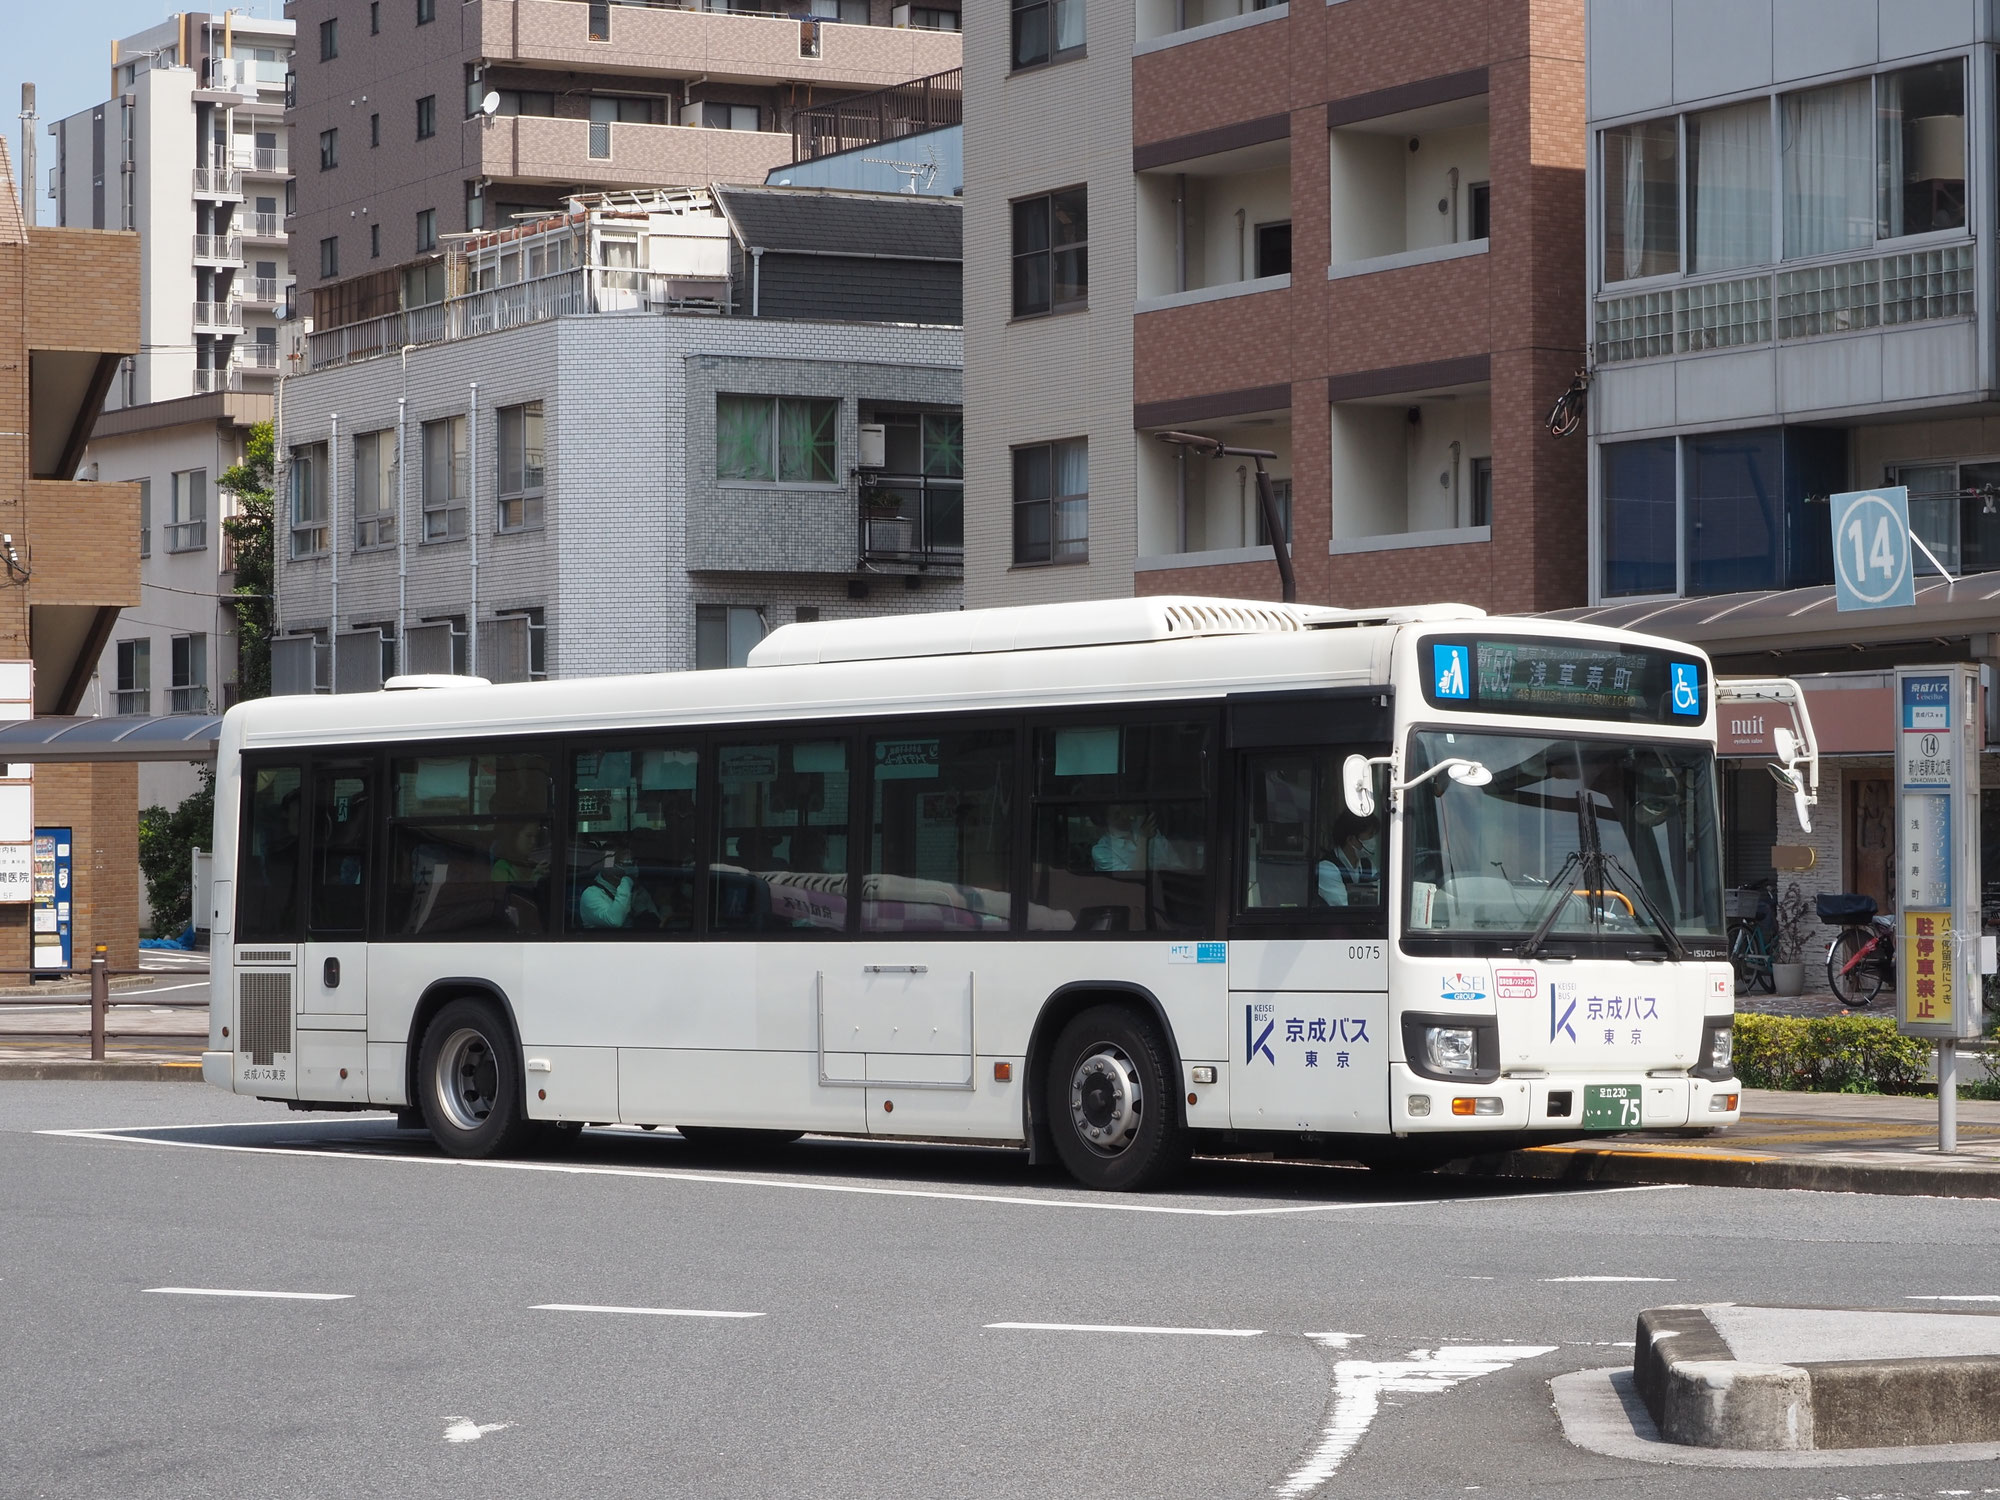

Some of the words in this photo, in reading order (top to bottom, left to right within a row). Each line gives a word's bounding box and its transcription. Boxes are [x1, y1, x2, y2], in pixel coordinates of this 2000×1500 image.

[1848, 516, 1895, 582] 14
[1528, 660, 1633, 693] 浅草寿町
[1518, 689, 1561, 701] ASAKUSA
[1568, 692, 1636, 706] KOTOBUKICHO
[1911, 683, 1948, 693] 京成バス
[1731, 716, 1764, 735] nuit
[1911, 819, 1920, 900] 浅草寿町
[1349, 946, 1380, 959] 0075
[1916, 917, 1935, 1018] 駐停車禁止
[1714, 982, 1725, 992] IC
[1587, 996, 1658, 1020] 京成バス
[1285, 1017, 1370, 1043] 京成バス
[1604, 1028, 1642, 1045] 東京
[1305, 1050, 1350, 1068] 東京
[243, 1068, 286, 1081] 京成バス東京
[1620, 1099, 1640, 1125] 75
